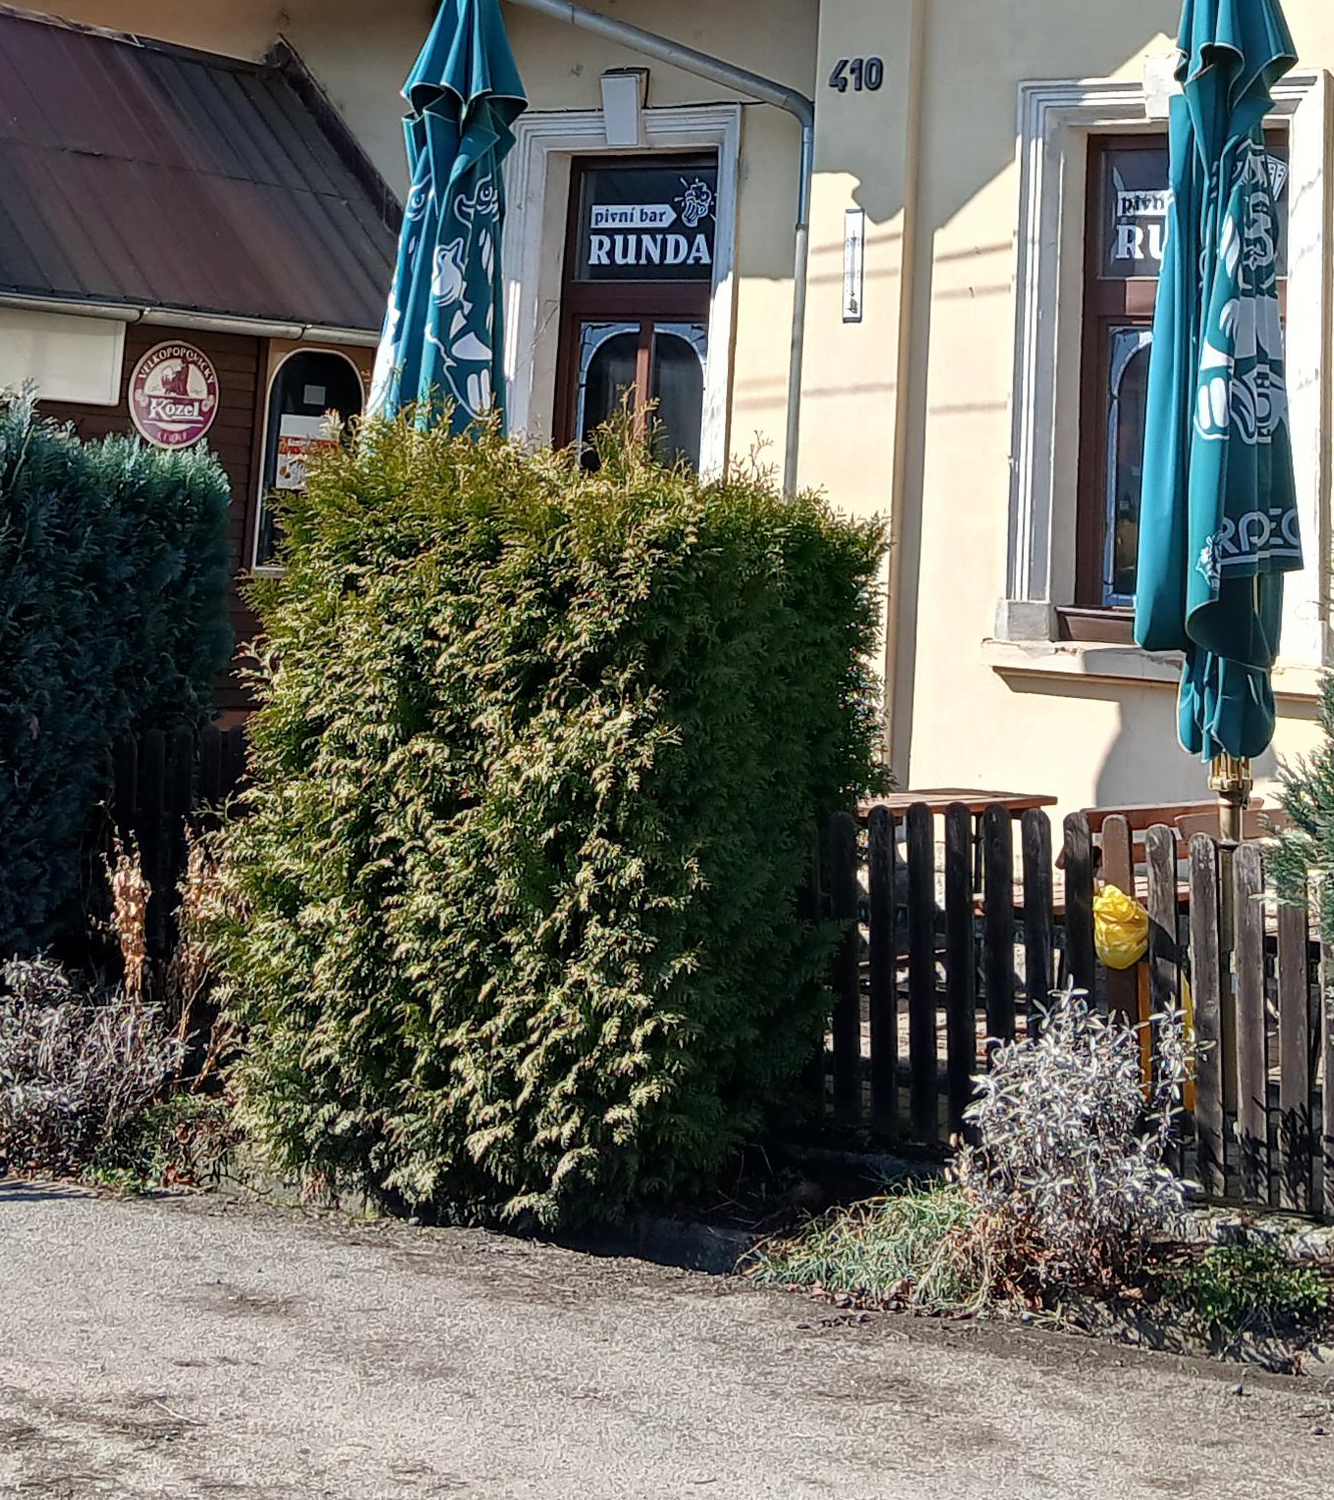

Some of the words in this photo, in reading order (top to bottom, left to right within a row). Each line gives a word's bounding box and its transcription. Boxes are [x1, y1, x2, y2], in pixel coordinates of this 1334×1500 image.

[829, 56, 884, 93] 410
[595, 207, 635, 226] pivní
[640, 208, 667, 223] bar
[1122, 193, 1165, 214] pivn
[588, 233, 712, 265] RUNDA
[1116, 224, 1163, 260] RU
[148, 398, 204, 421] Kozel
